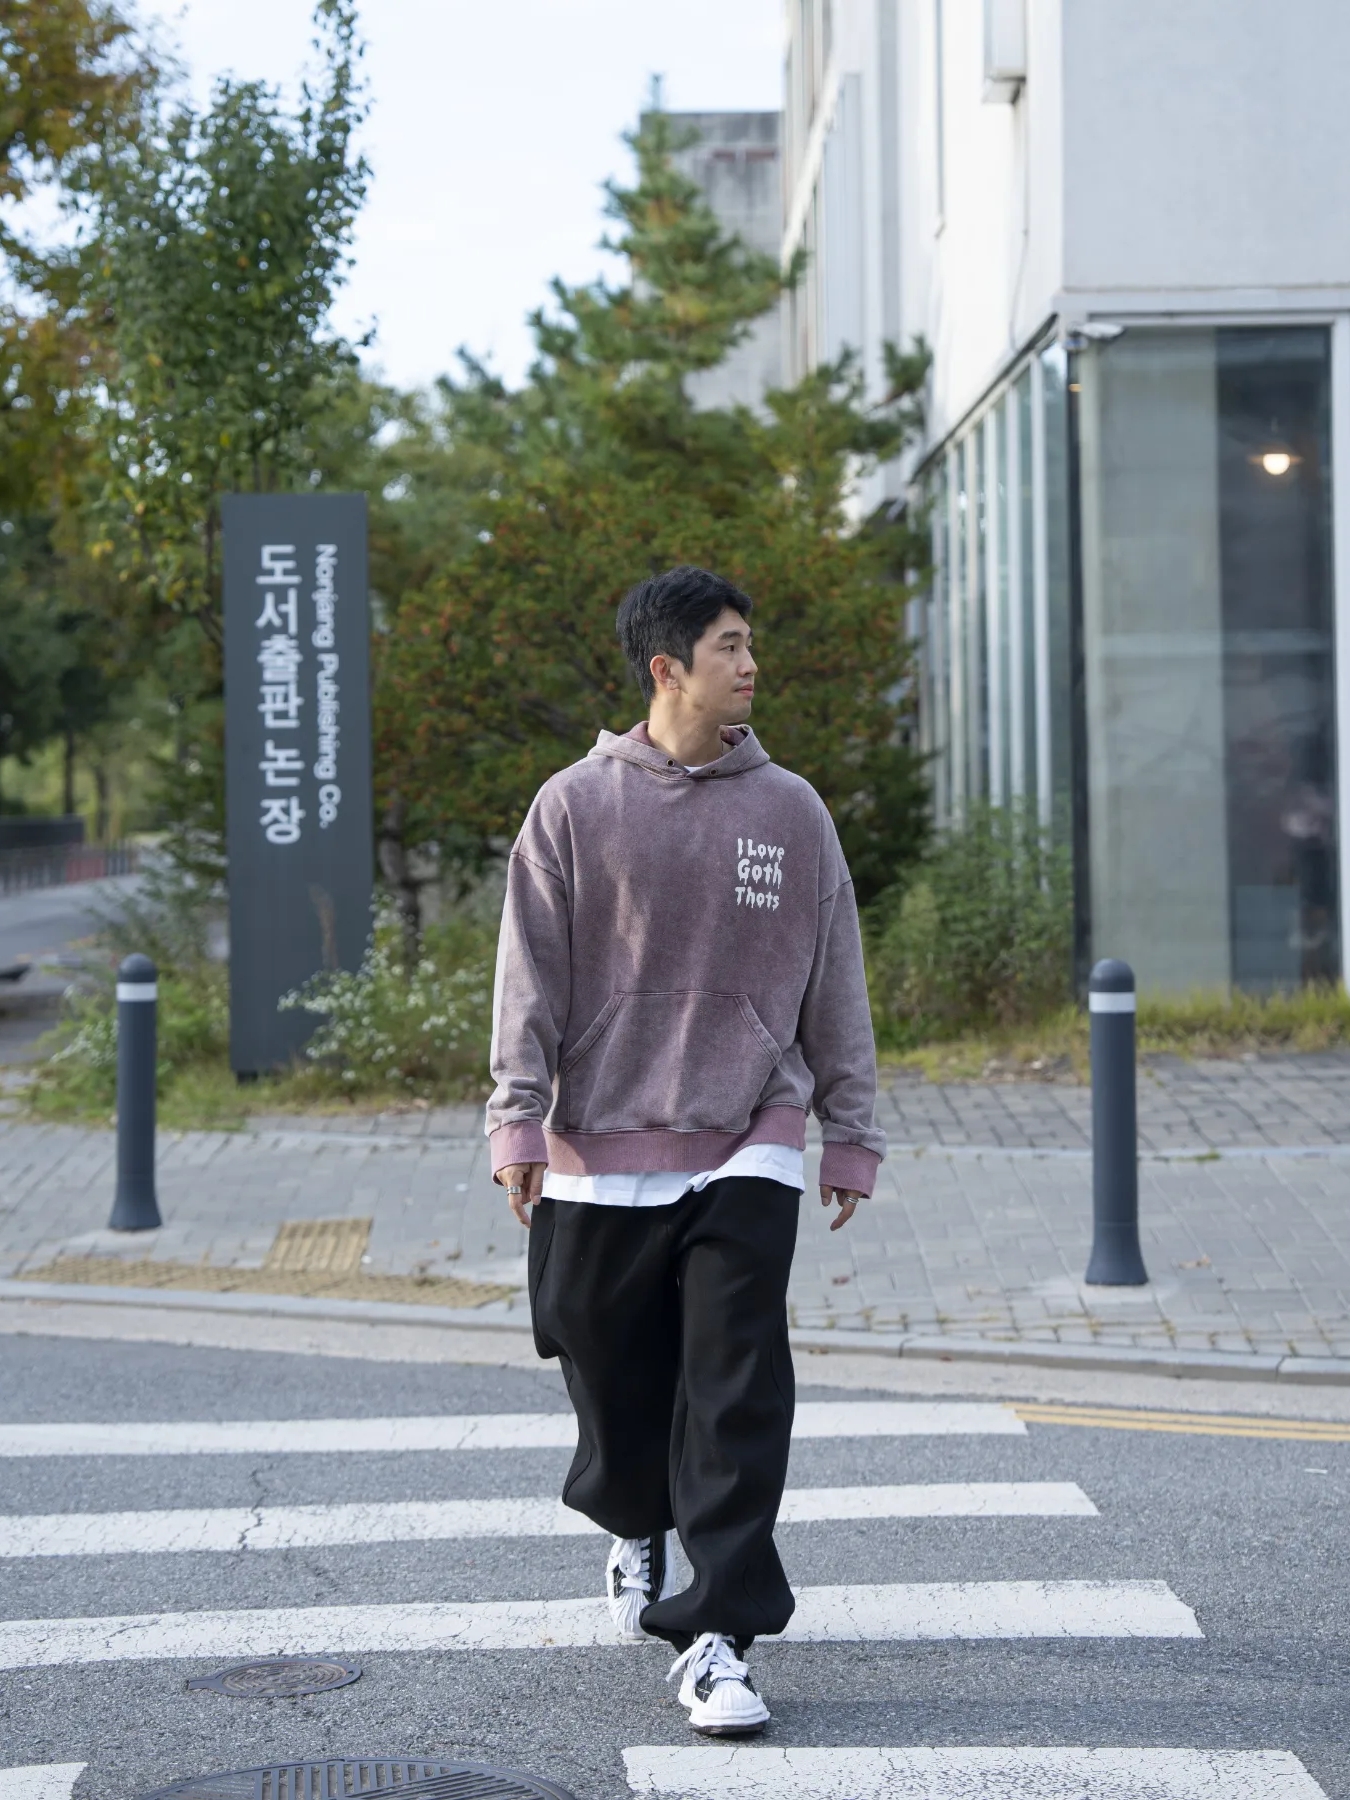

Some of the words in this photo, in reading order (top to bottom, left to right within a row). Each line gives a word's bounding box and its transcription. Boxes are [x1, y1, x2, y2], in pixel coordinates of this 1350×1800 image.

[311, 544, 339, 648] Nonjang
[255, 544, 305, 728] 도서출판
[313, 653, 340, 780] Publishing
[318, 784, 342, 829] Co.
[738, 838, 743, 858] I
[748, 839, 785, 863] Love
[738, 859, 782, 889] Goth
[735, 886, 779, 911] Thots
